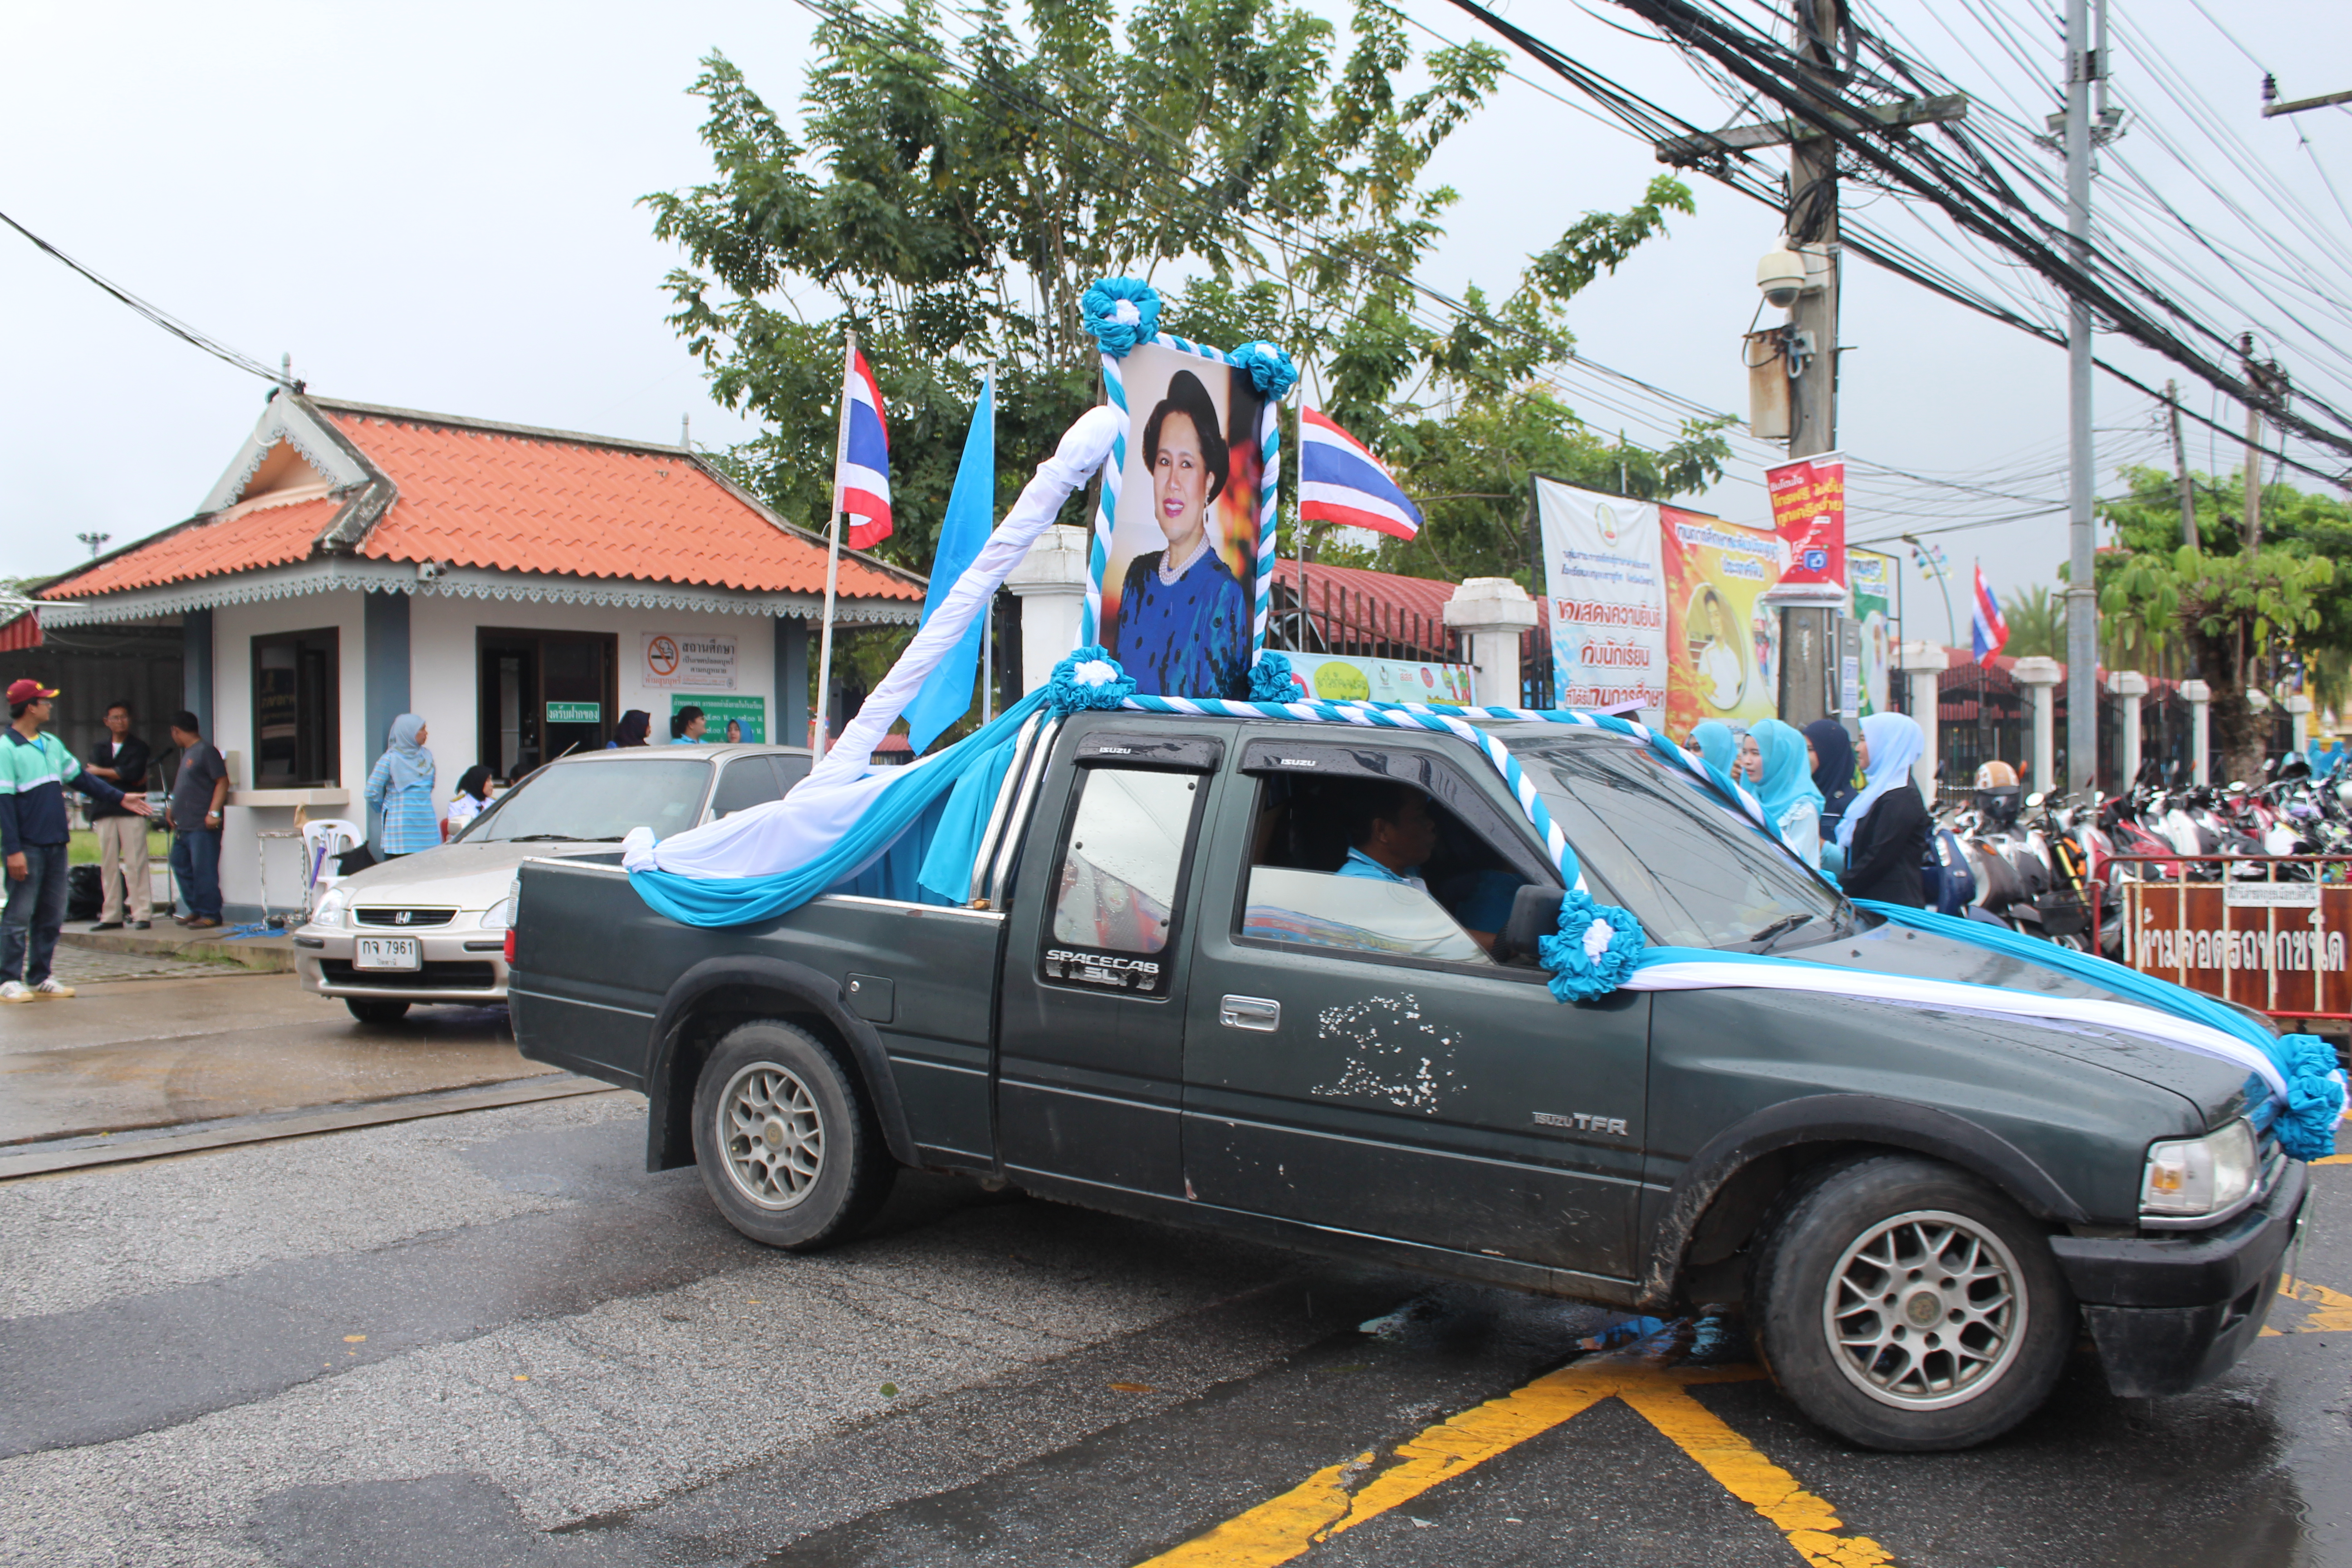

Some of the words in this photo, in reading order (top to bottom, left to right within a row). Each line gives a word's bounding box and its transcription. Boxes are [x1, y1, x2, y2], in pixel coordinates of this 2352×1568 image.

[682, 638, 735, 654] สถานศึกษา
[1581, 637, 1650, 667] กับนักเรียน
[548, 705, 598, 720] งดรับฝากของ
[363, 941, 379, 954] กจ
[386, 941, 413, 955] 7961
[1046, 950, 1159, 974] SPACECAB
[1084, 966, 1119, 981] SL
[1533, 1113, 1573, 1128] ISUZU
[1573, 1113, 1628, 1136] TFR
